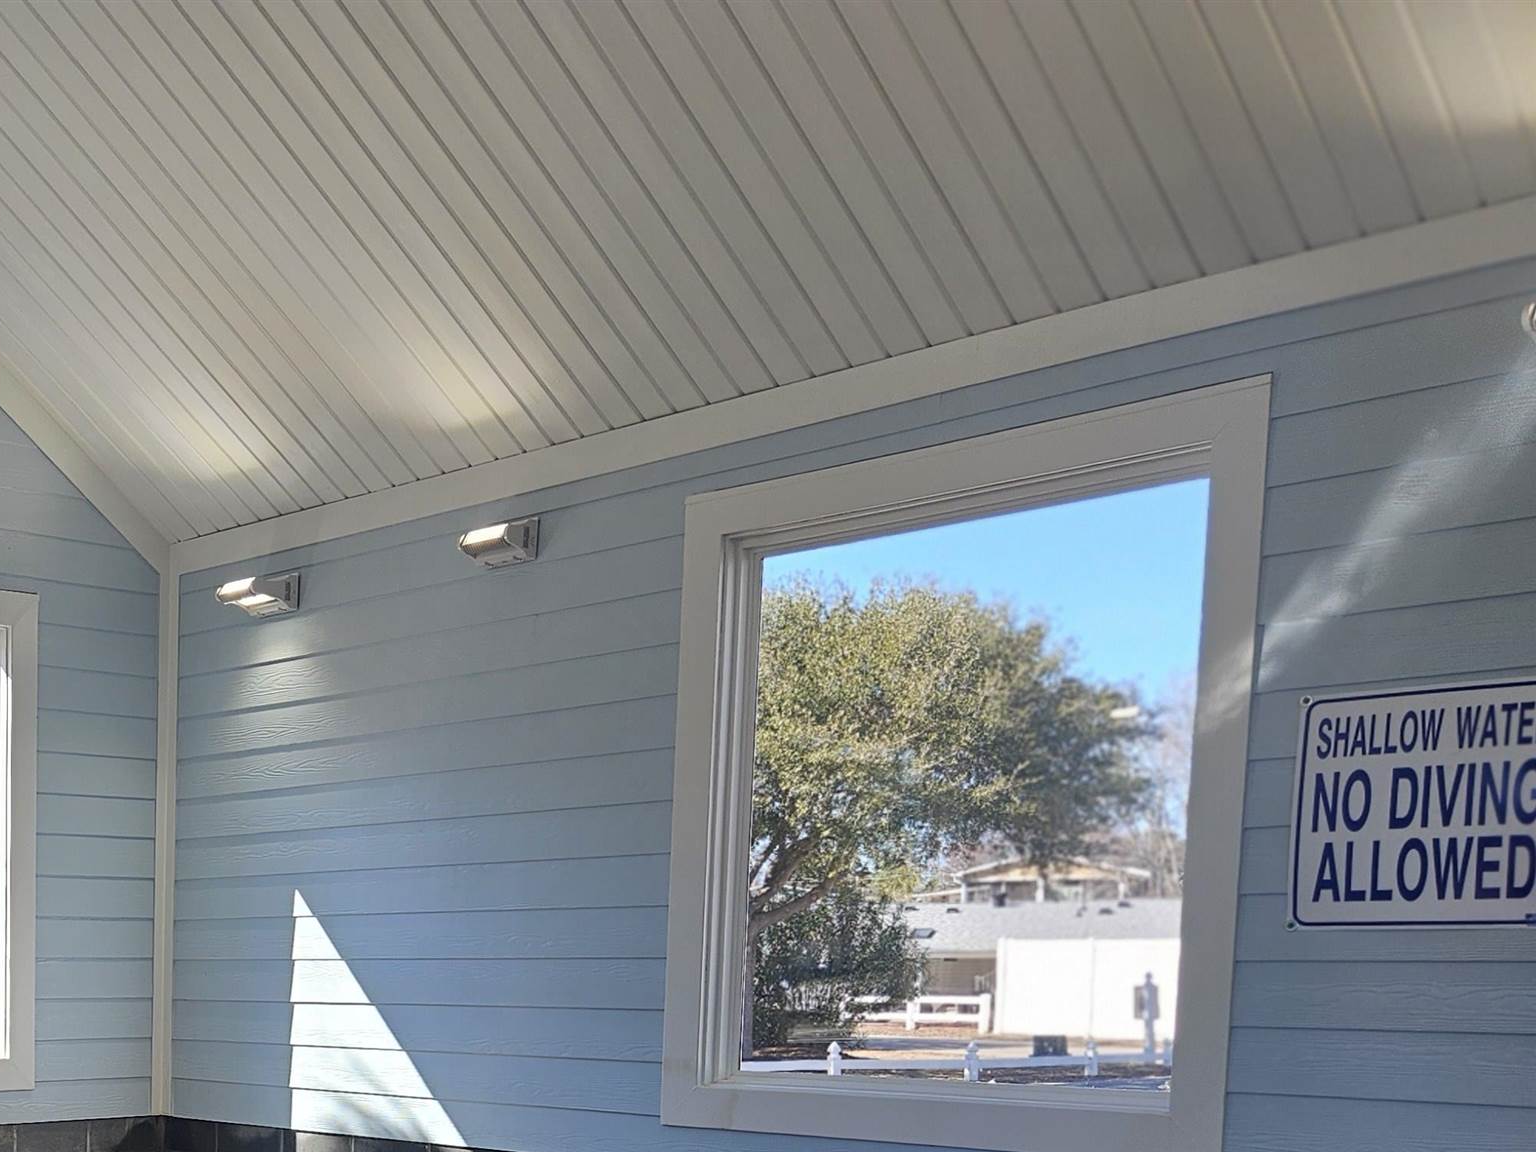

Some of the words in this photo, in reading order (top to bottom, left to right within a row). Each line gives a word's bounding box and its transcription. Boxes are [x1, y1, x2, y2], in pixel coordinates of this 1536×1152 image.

[1316, 708, 1445, 759] SHALLOW
[1456, 701, 1536, 749] WATE
[1312, 769, 1372, 833] NO
[1388, 758, 1536, 829] DIVING
[1312, 834, 1536, 902] ALLOWED
